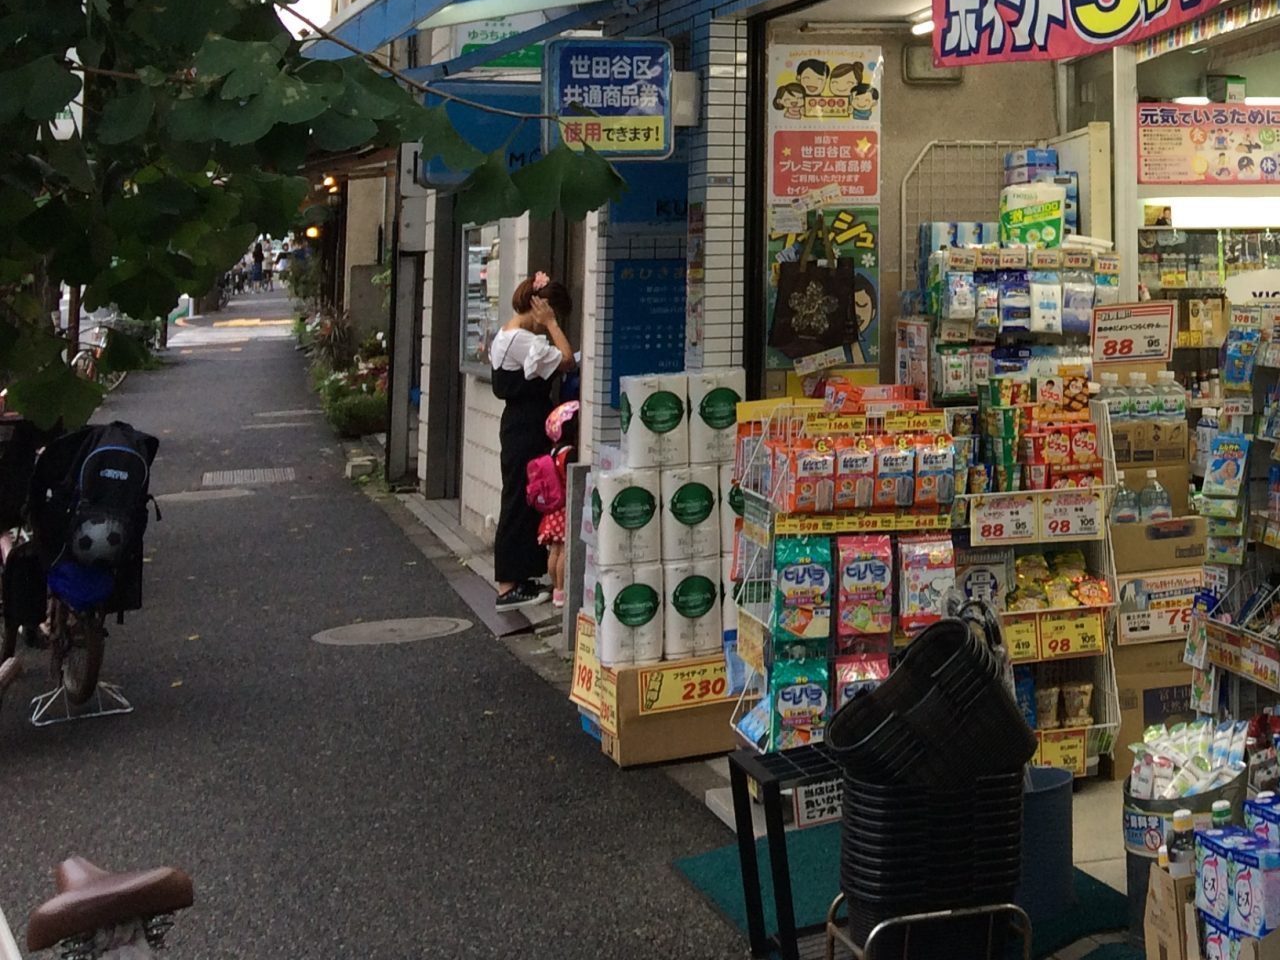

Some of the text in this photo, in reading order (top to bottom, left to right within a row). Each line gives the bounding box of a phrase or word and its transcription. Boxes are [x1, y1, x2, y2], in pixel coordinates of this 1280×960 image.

[570, 55, 652, 80] 世田谷区
[563, 84, 659, 109] 共通商品券
[801, 145, 852, 158] 世田谷区
[780, 159, 873, 173] プレミアム商品券
[1103, 338, 1134, 356] 88
[1047, 440, 1068, 453] ビスコ
[1074, 438, 1095, 451] ビスコ
[981, 523, 1005, 538] 88
[1048, 519, 1071, 534] 98
[1048, 637, 1072, 653] 98
[682, 678, 727, 701] 230
